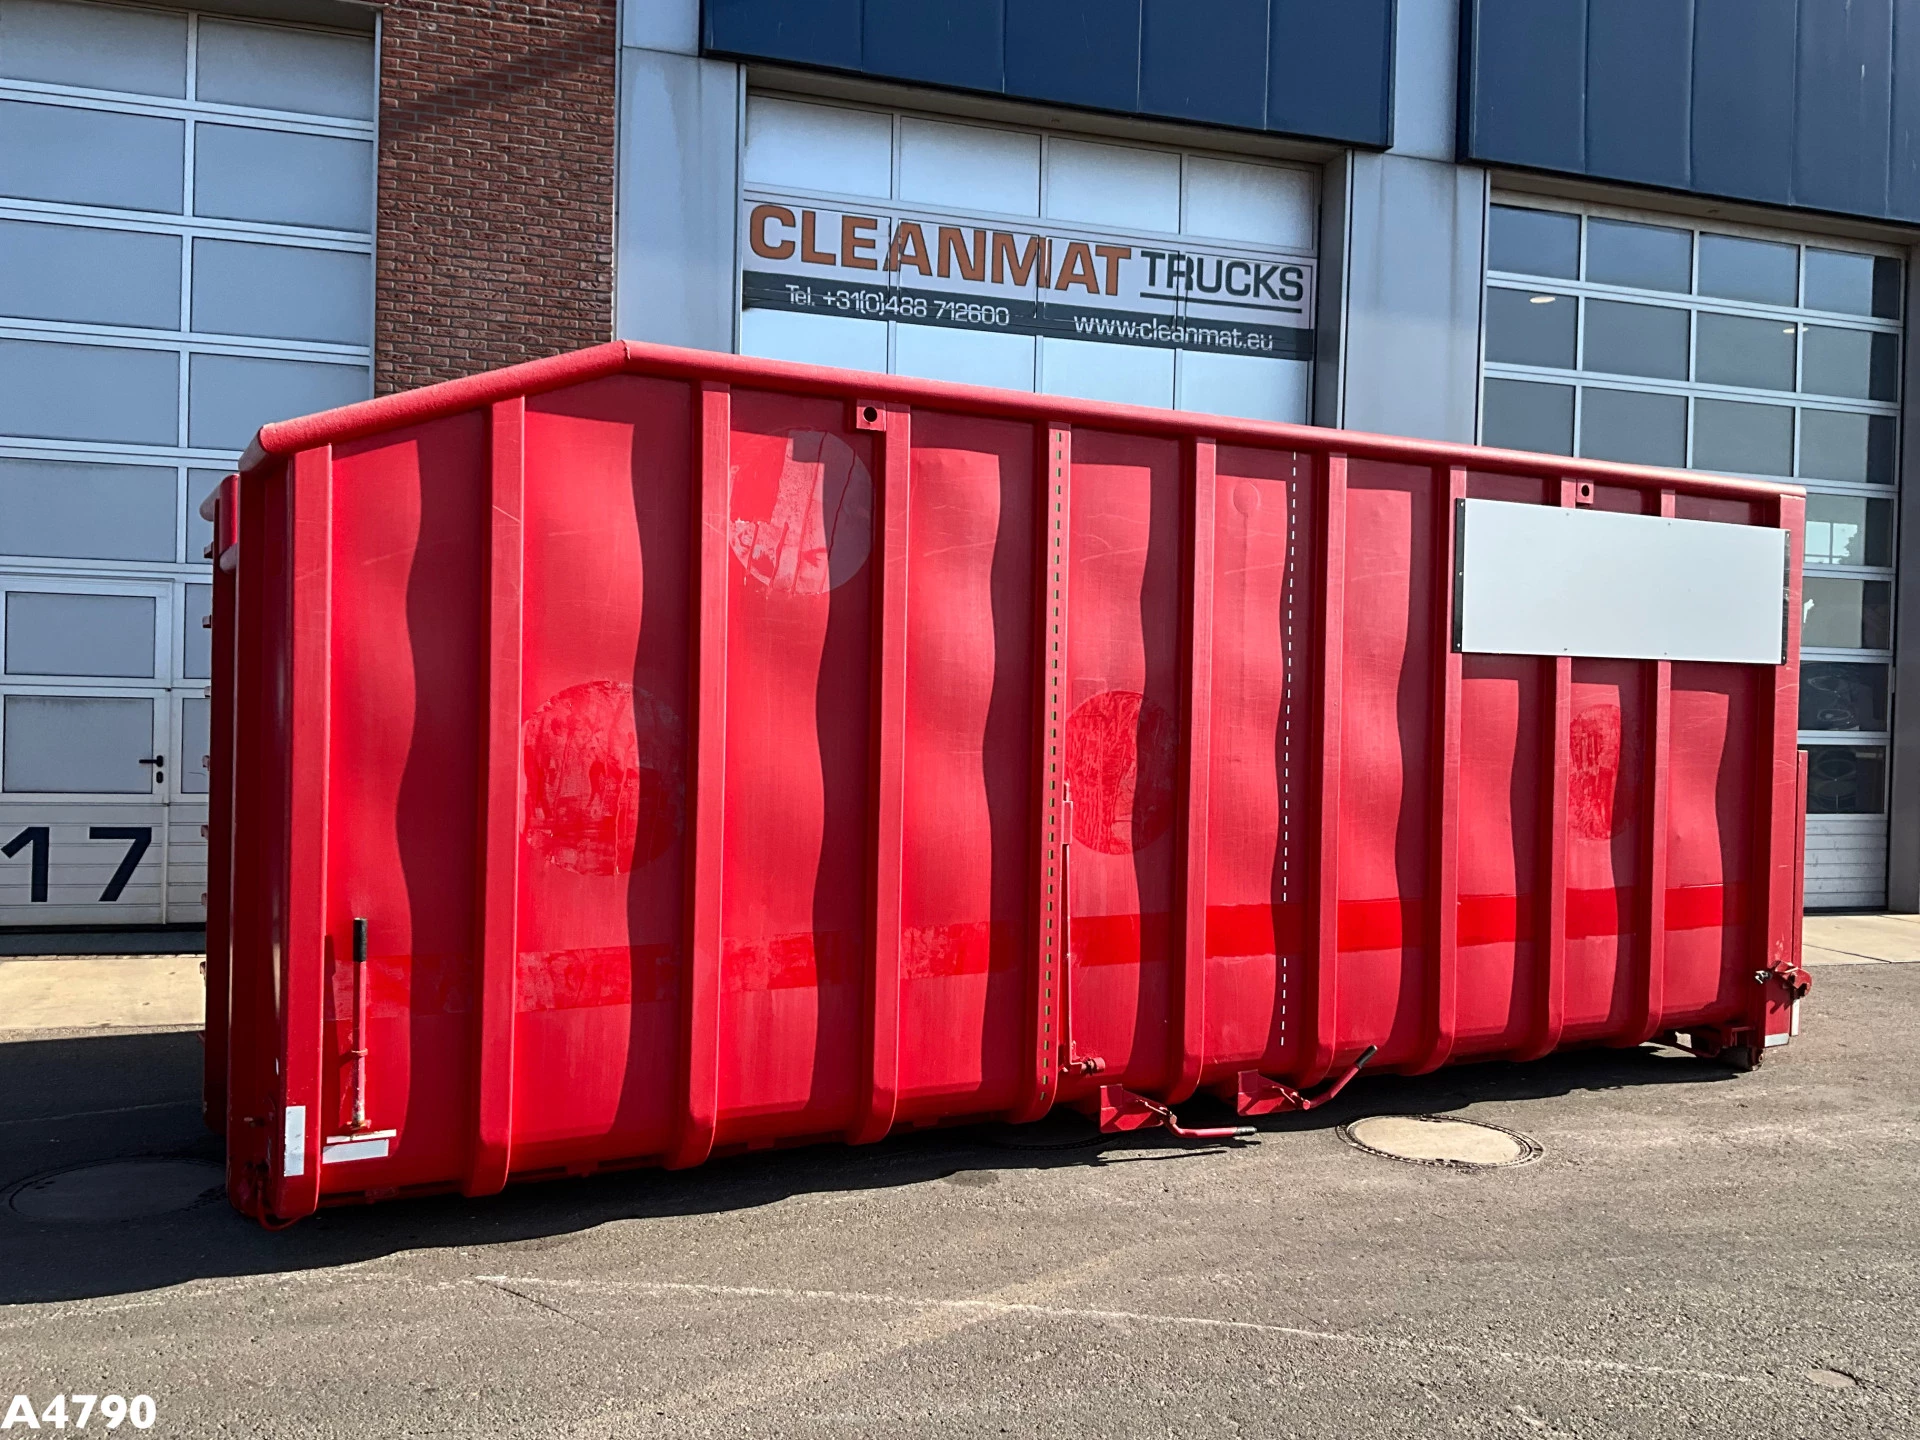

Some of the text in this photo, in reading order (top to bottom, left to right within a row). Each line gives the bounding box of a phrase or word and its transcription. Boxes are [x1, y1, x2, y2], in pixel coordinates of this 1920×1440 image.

[750, 204, 1304, 302] CLEANMAT TRUCKS
[785, 284, 1010, 326] Tel. +31(0)488 712600
[1073, 315, 1273, 351] www.cleanmat.eu
[0, 826, 152, 903] 17
